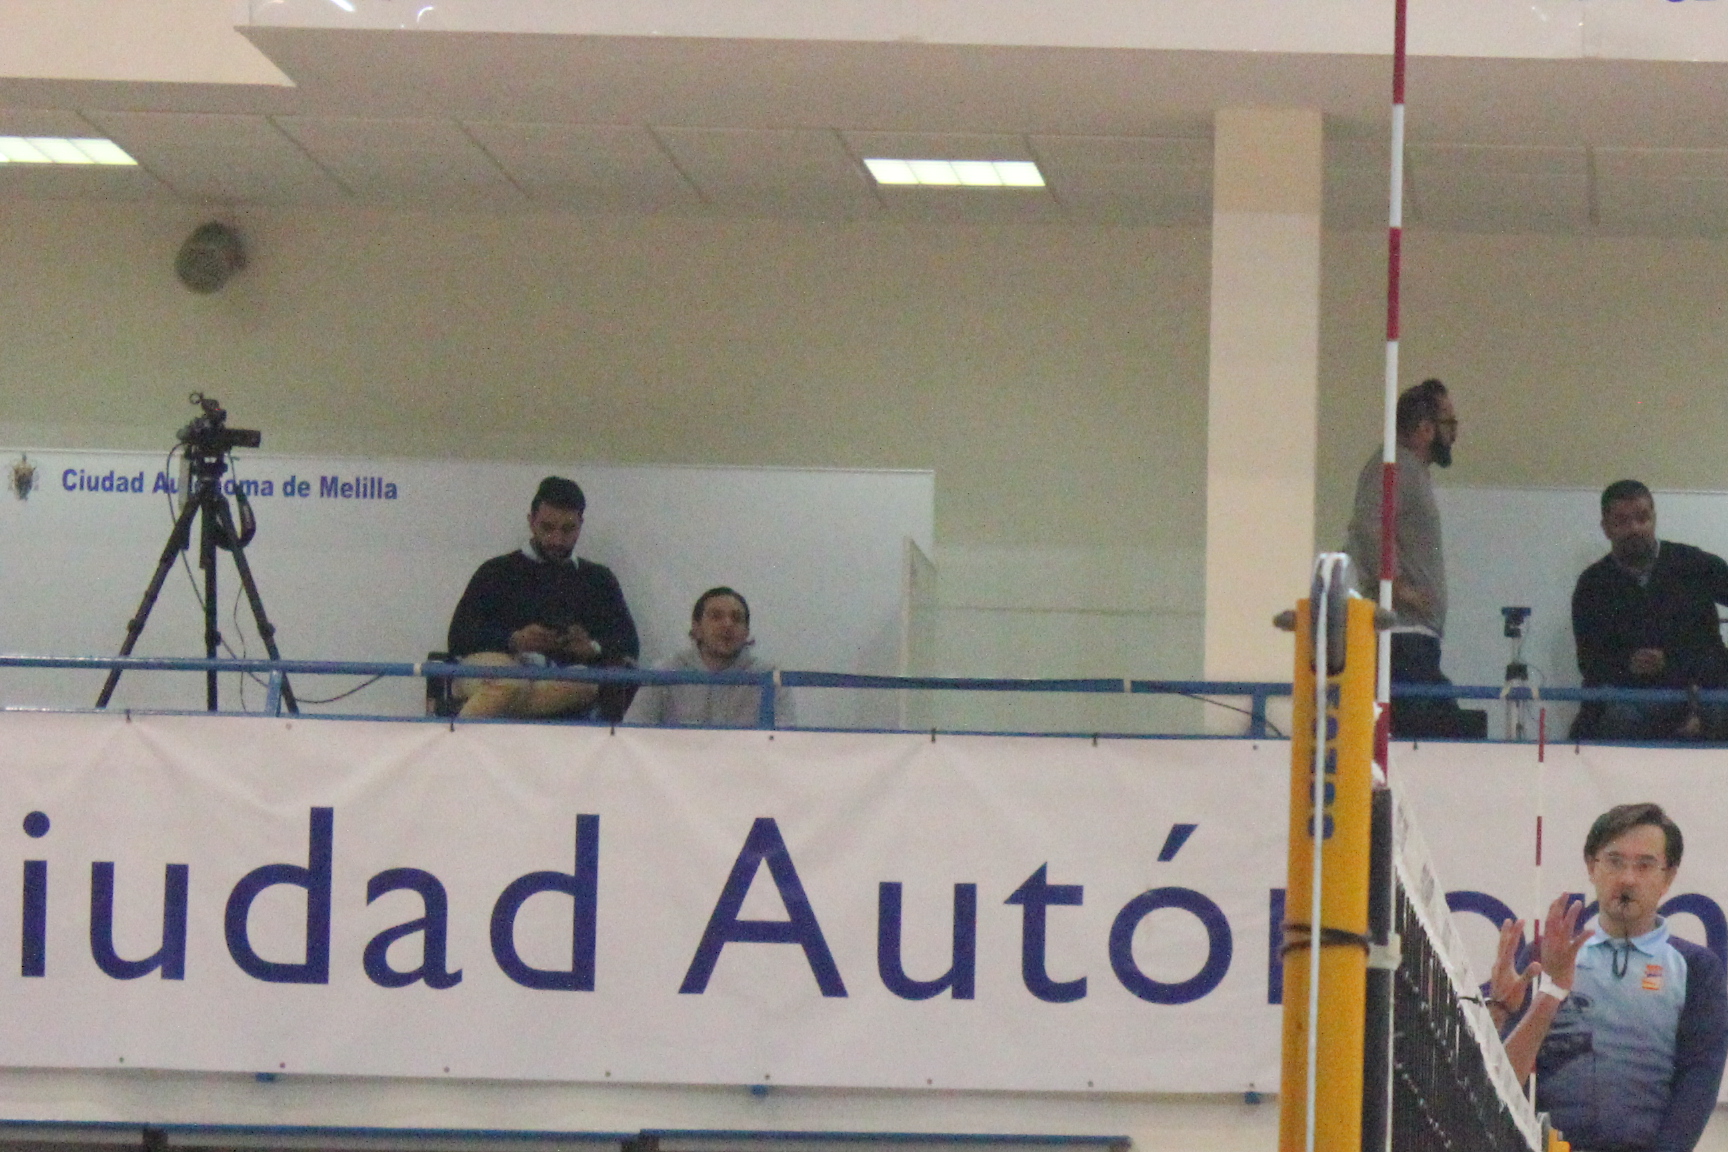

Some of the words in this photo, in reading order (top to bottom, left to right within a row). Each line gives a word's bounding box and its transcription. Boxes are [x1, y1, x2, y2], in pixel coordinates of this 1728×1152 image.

[62, 468, 144, 493] Ciudad
[152, 471, 274, 497] Auoma
[283, 475, 310, 497] de
[319, 475, 398, 500] Melilla
[21, 807, 600, 991] iudad
